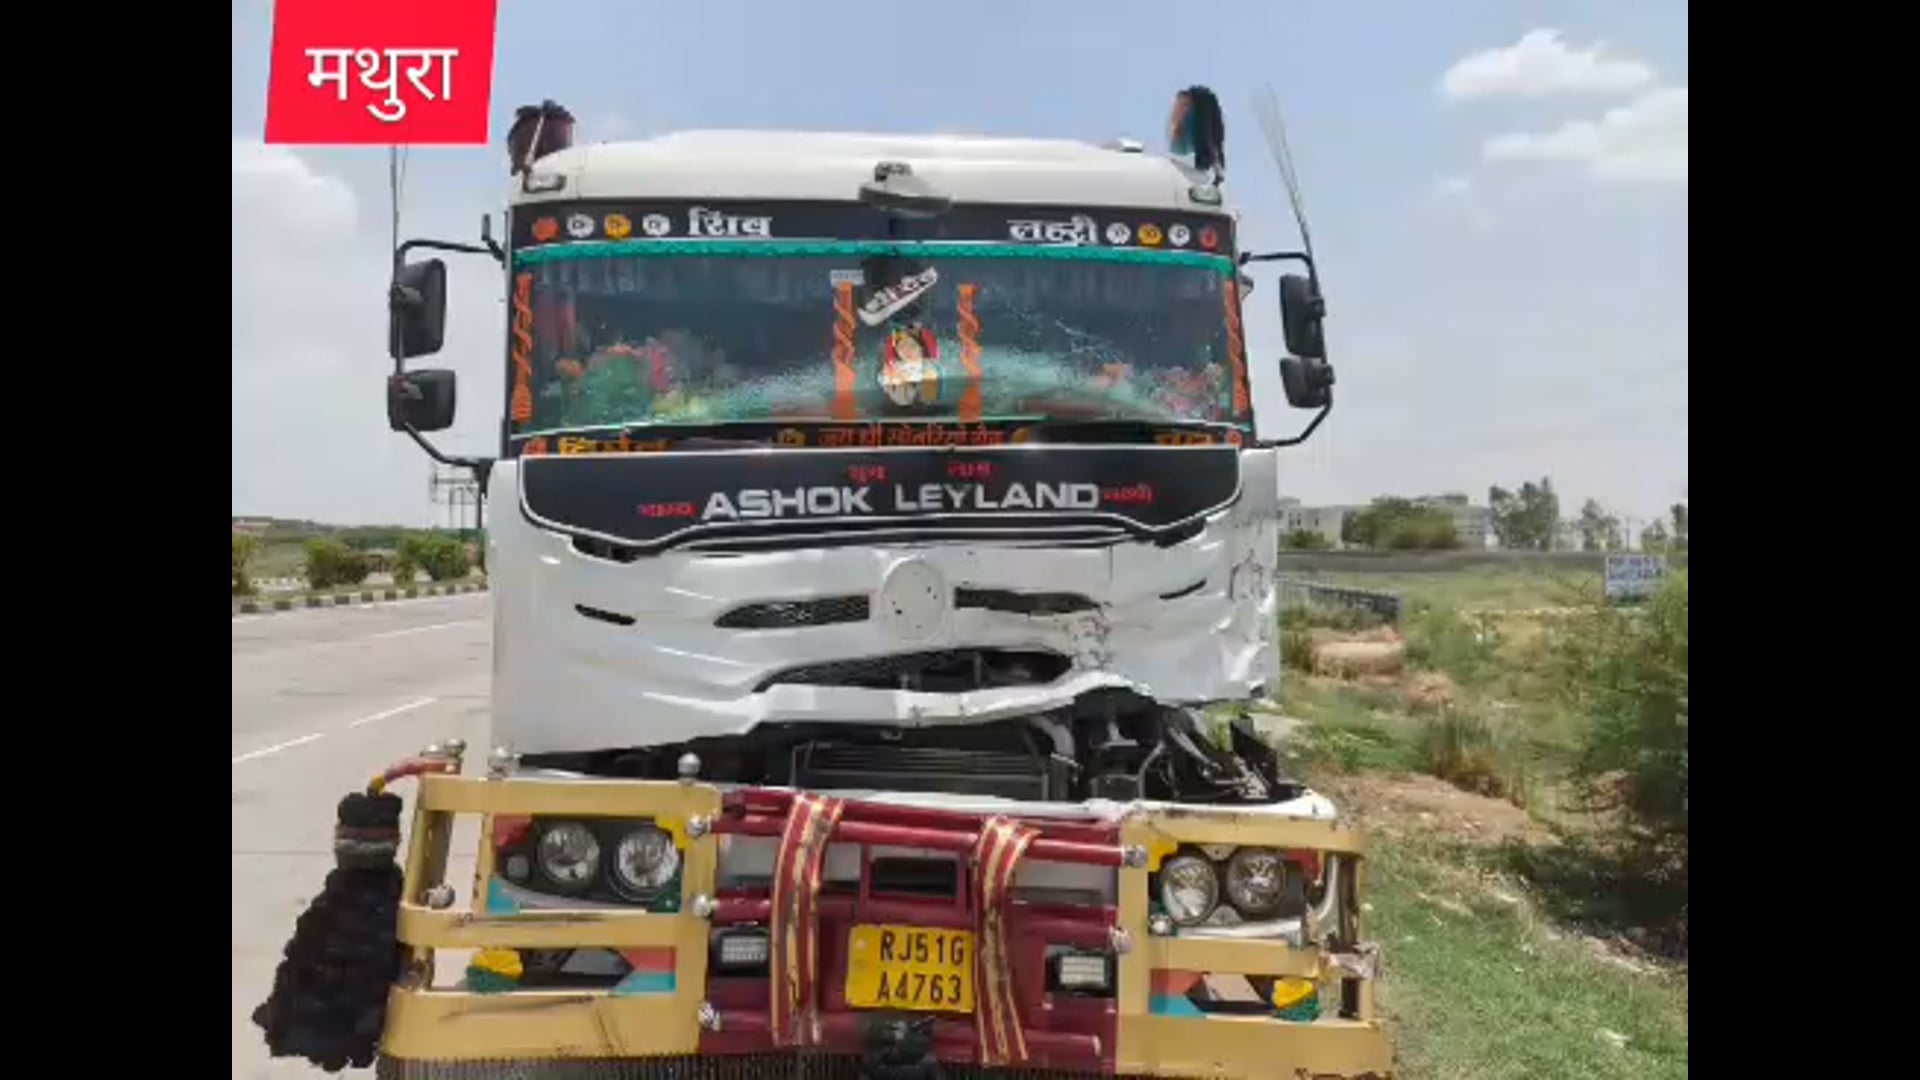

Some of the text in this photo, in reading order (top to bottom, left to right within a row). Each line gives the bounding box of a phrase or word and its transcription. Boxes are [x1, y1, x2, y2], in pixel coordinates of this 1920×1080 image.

[701, 486, 874, 520] ASHOK
[895, 482, 1099, 510] LEYLAND
[880, 930, 964, 966] RJ51G
[877, 971, 961, 1004] A4763
